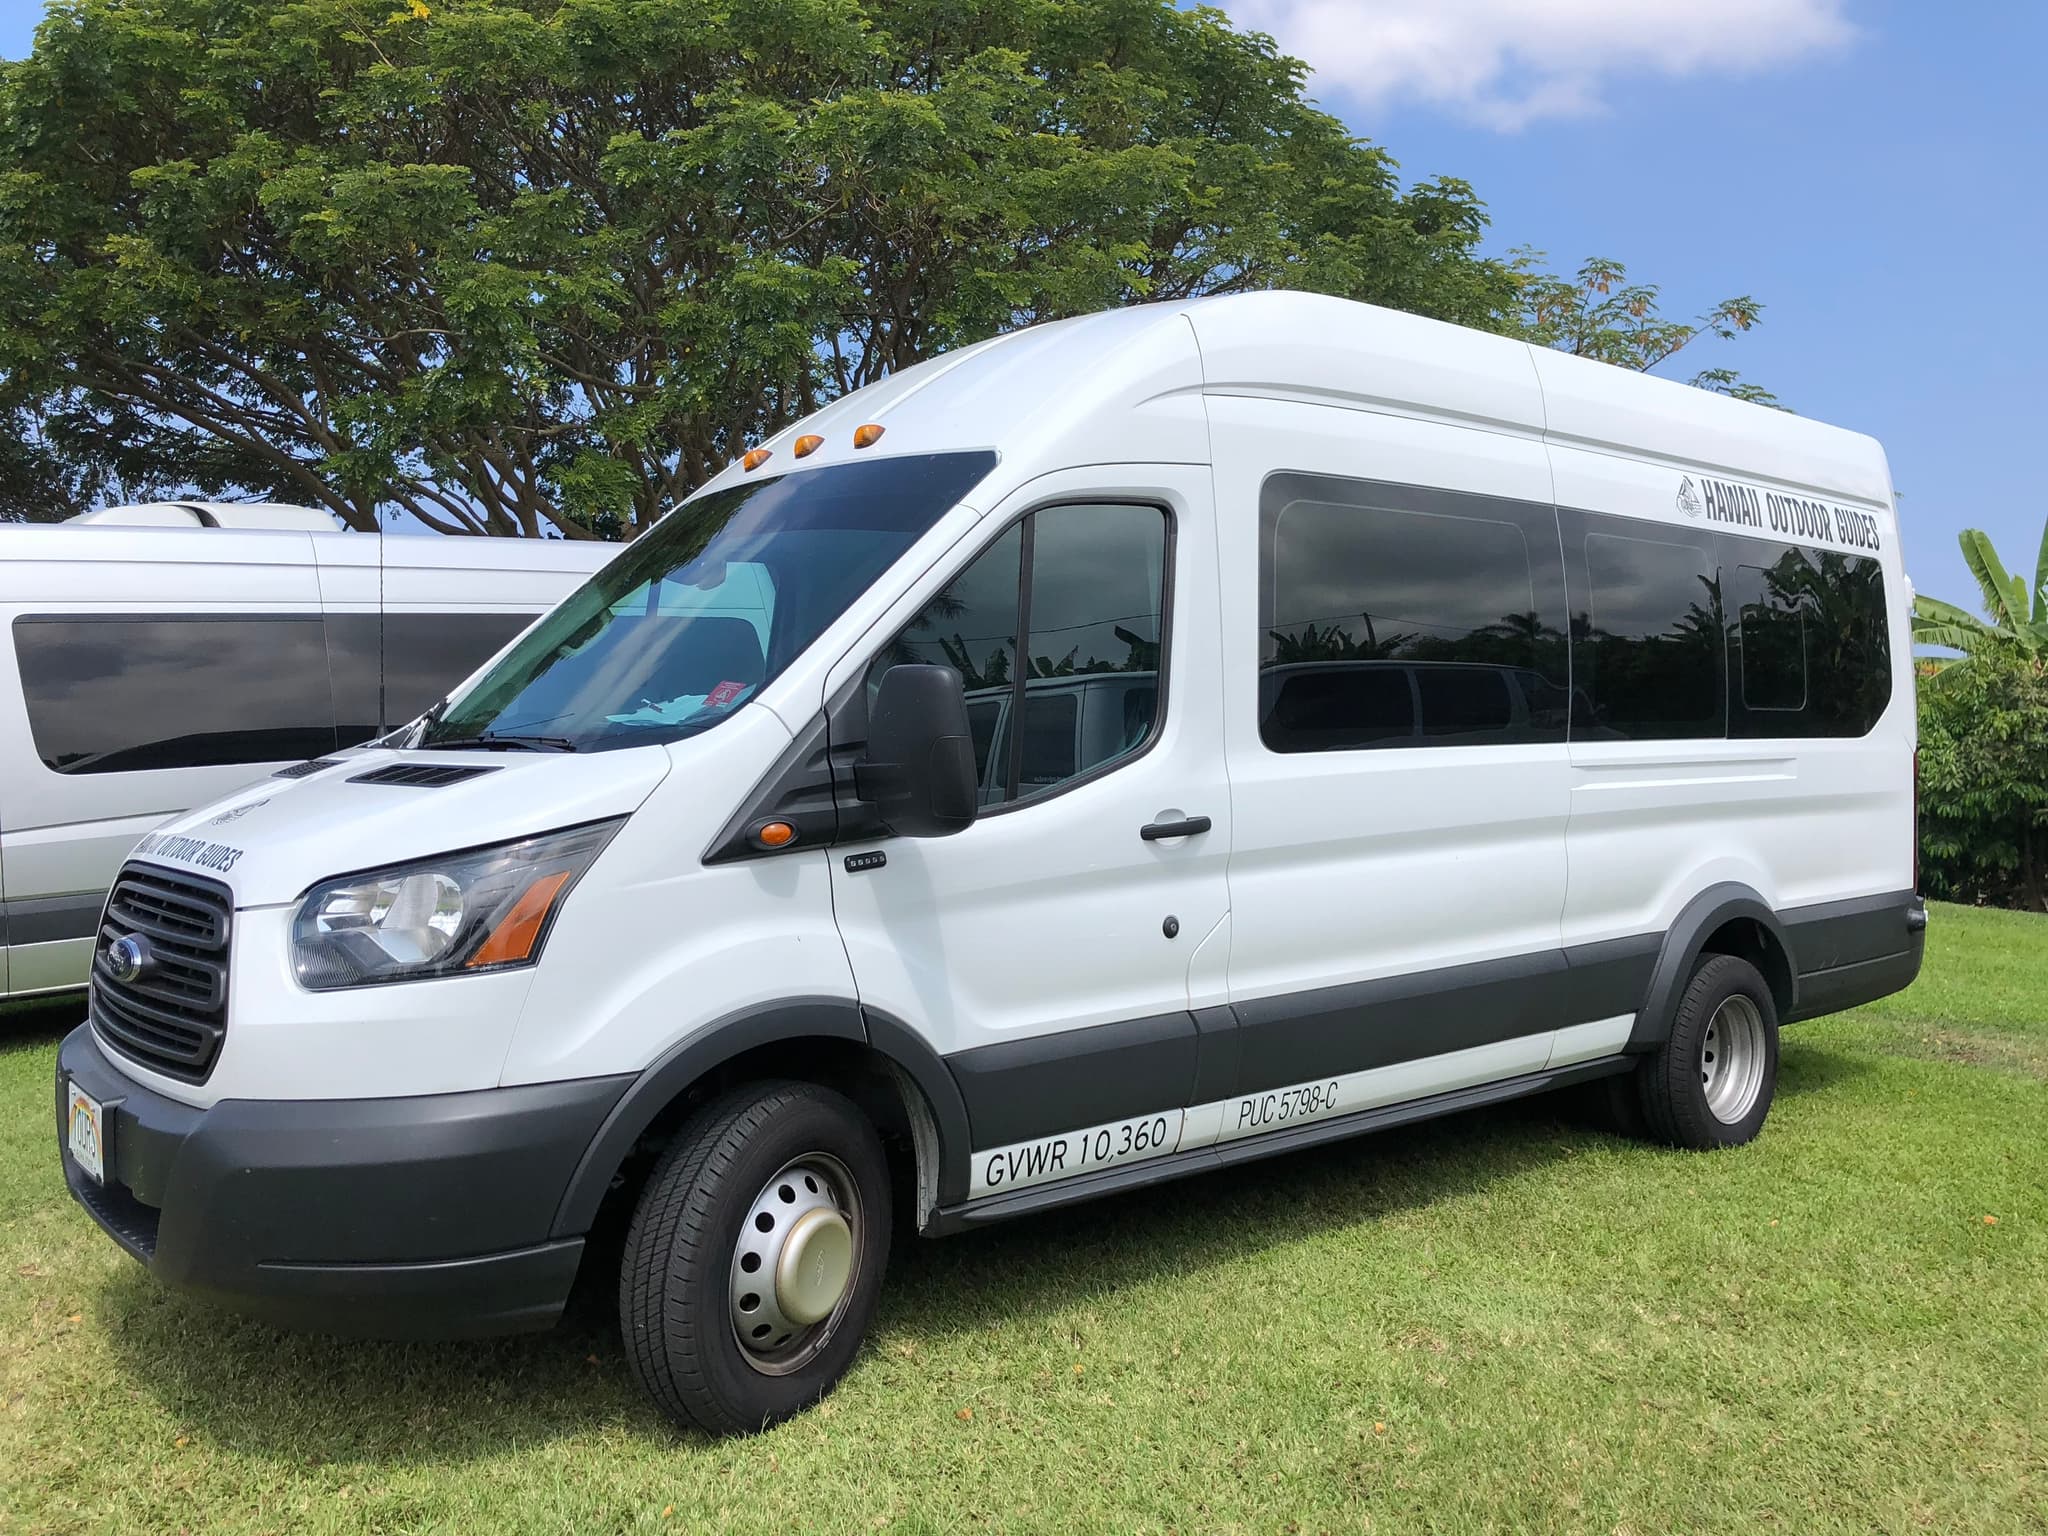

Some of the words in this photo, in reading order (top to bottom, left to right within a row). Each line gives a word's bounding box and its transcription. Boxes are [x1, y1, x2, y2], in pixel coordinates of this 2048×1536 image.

[1700, 479, 1762, 528] HAWAII
[1765, 492, 1833, 543] OUTDOOR
[1834, 507, 1880, 551] GUIDES
[156, 836, 206, 863] OUTDOOR
[195, 843, 244, 873] GUIDES
[1237, 1094, 1277, 1130] PUC
[1280, 1081, 1339, 1120] 5798-C
[985, 1139, 1068, 1187] GVWR
[1080, 1117, 1167, 1164] 10,360
